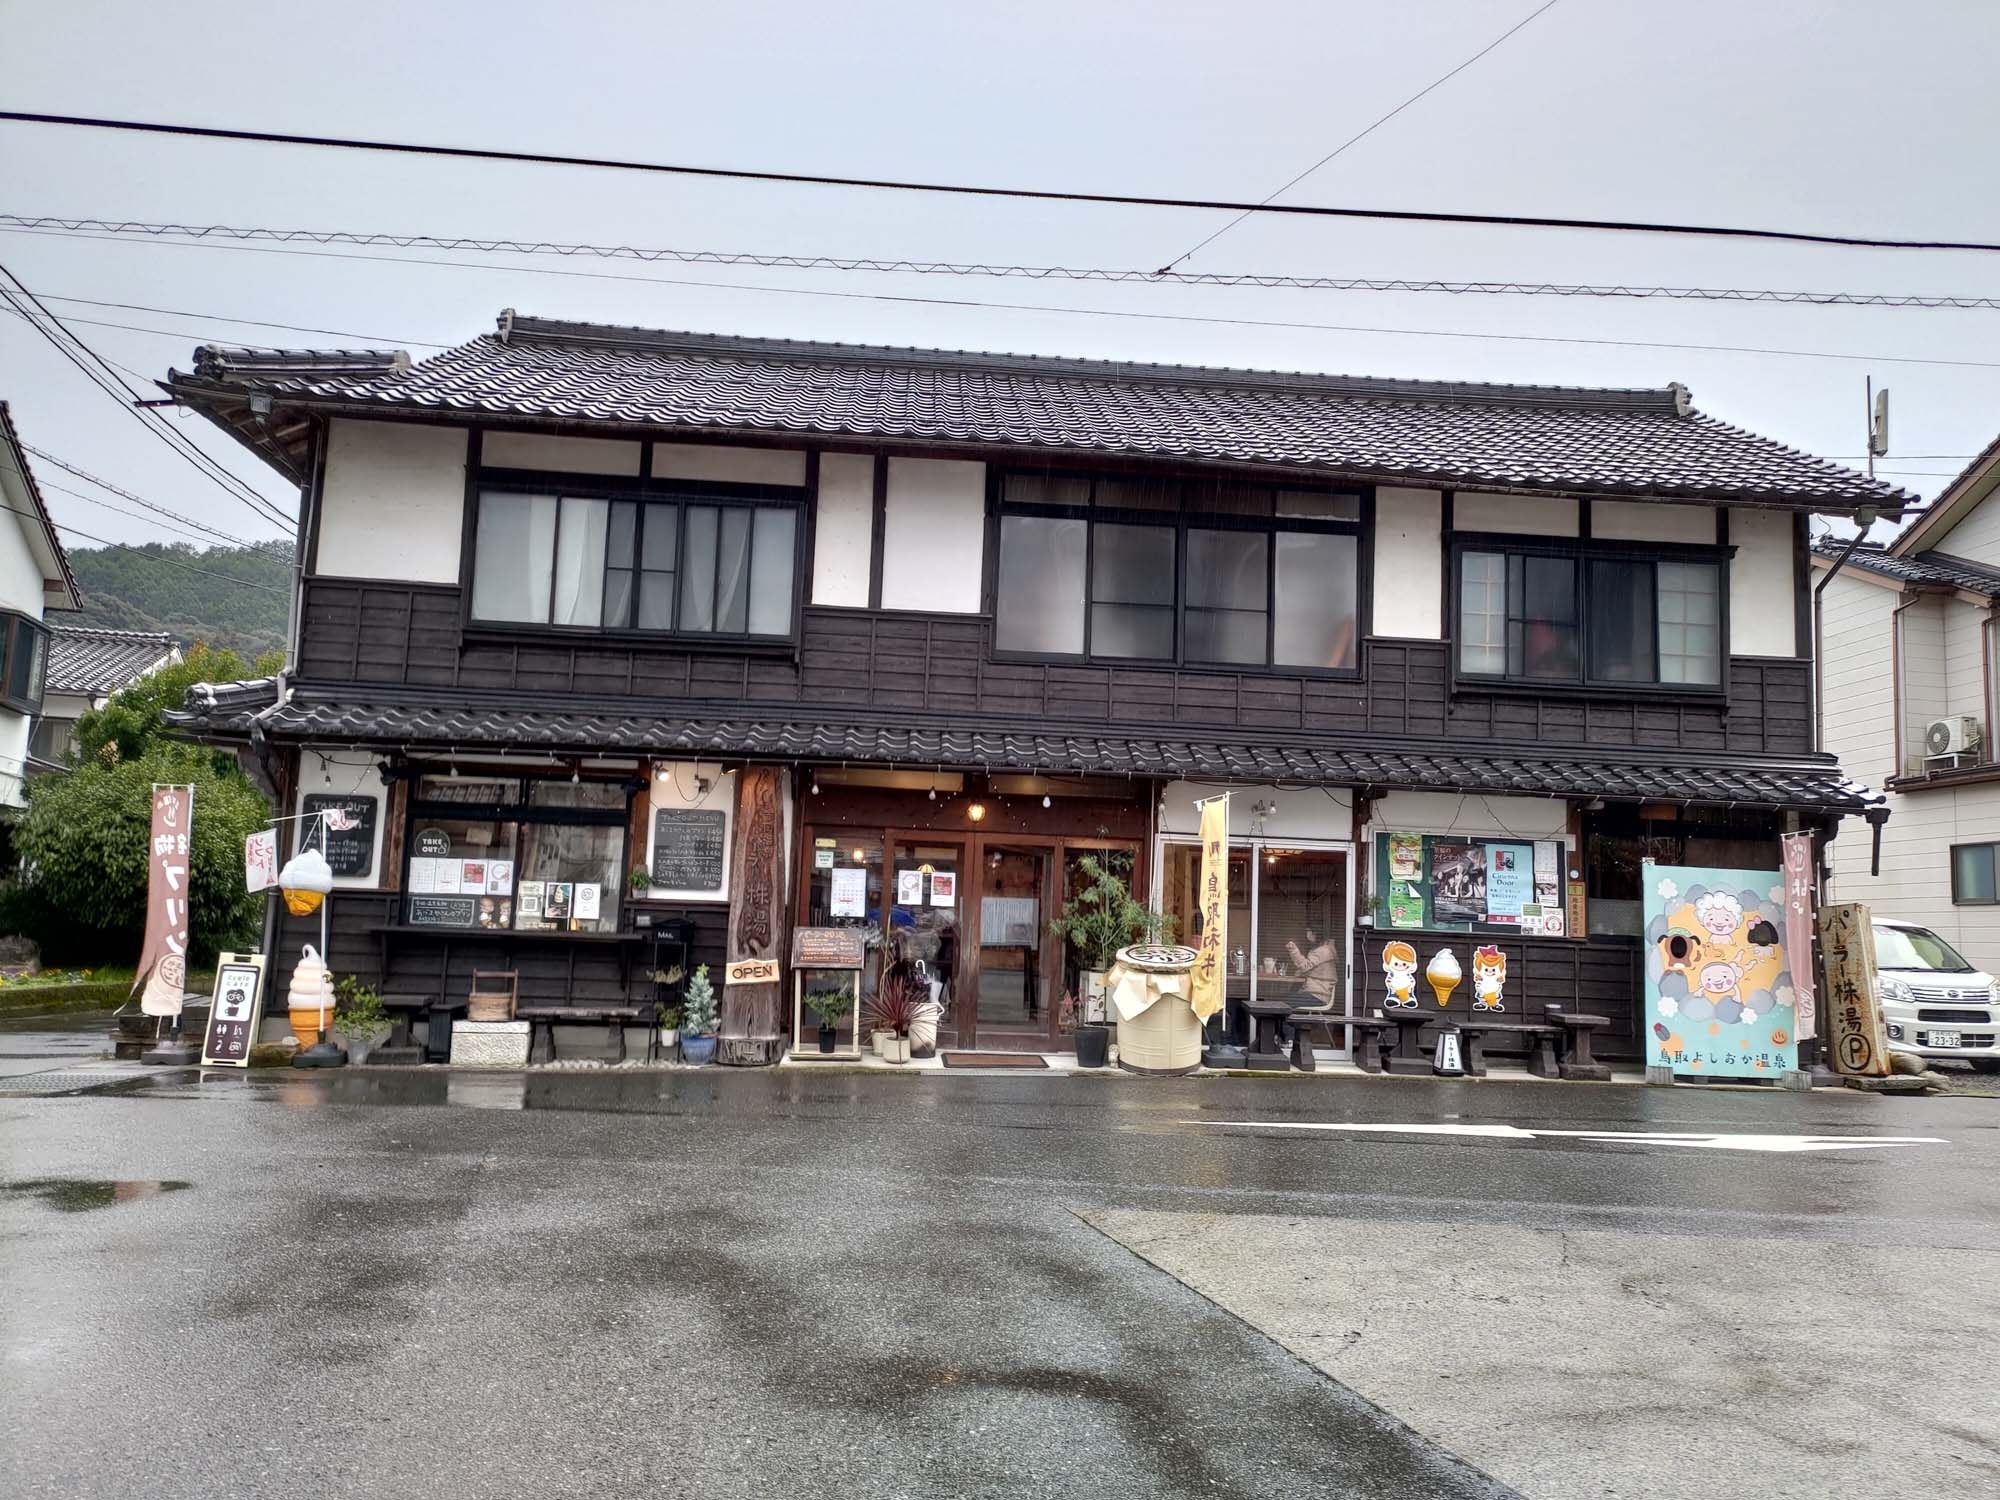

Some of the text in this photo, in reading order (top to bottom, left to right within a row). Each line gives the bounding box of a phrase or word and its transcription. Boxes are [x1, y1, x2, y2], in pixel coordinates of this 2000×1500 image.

[731, 964, 773, 980] OPEN
[1825, 909, 1861, 1034] パーラー株湯
[1935, 1036, 1960, 1046] 23-32
[1658, 1048, 1787, 1069] 鳥取よしおか温泉
